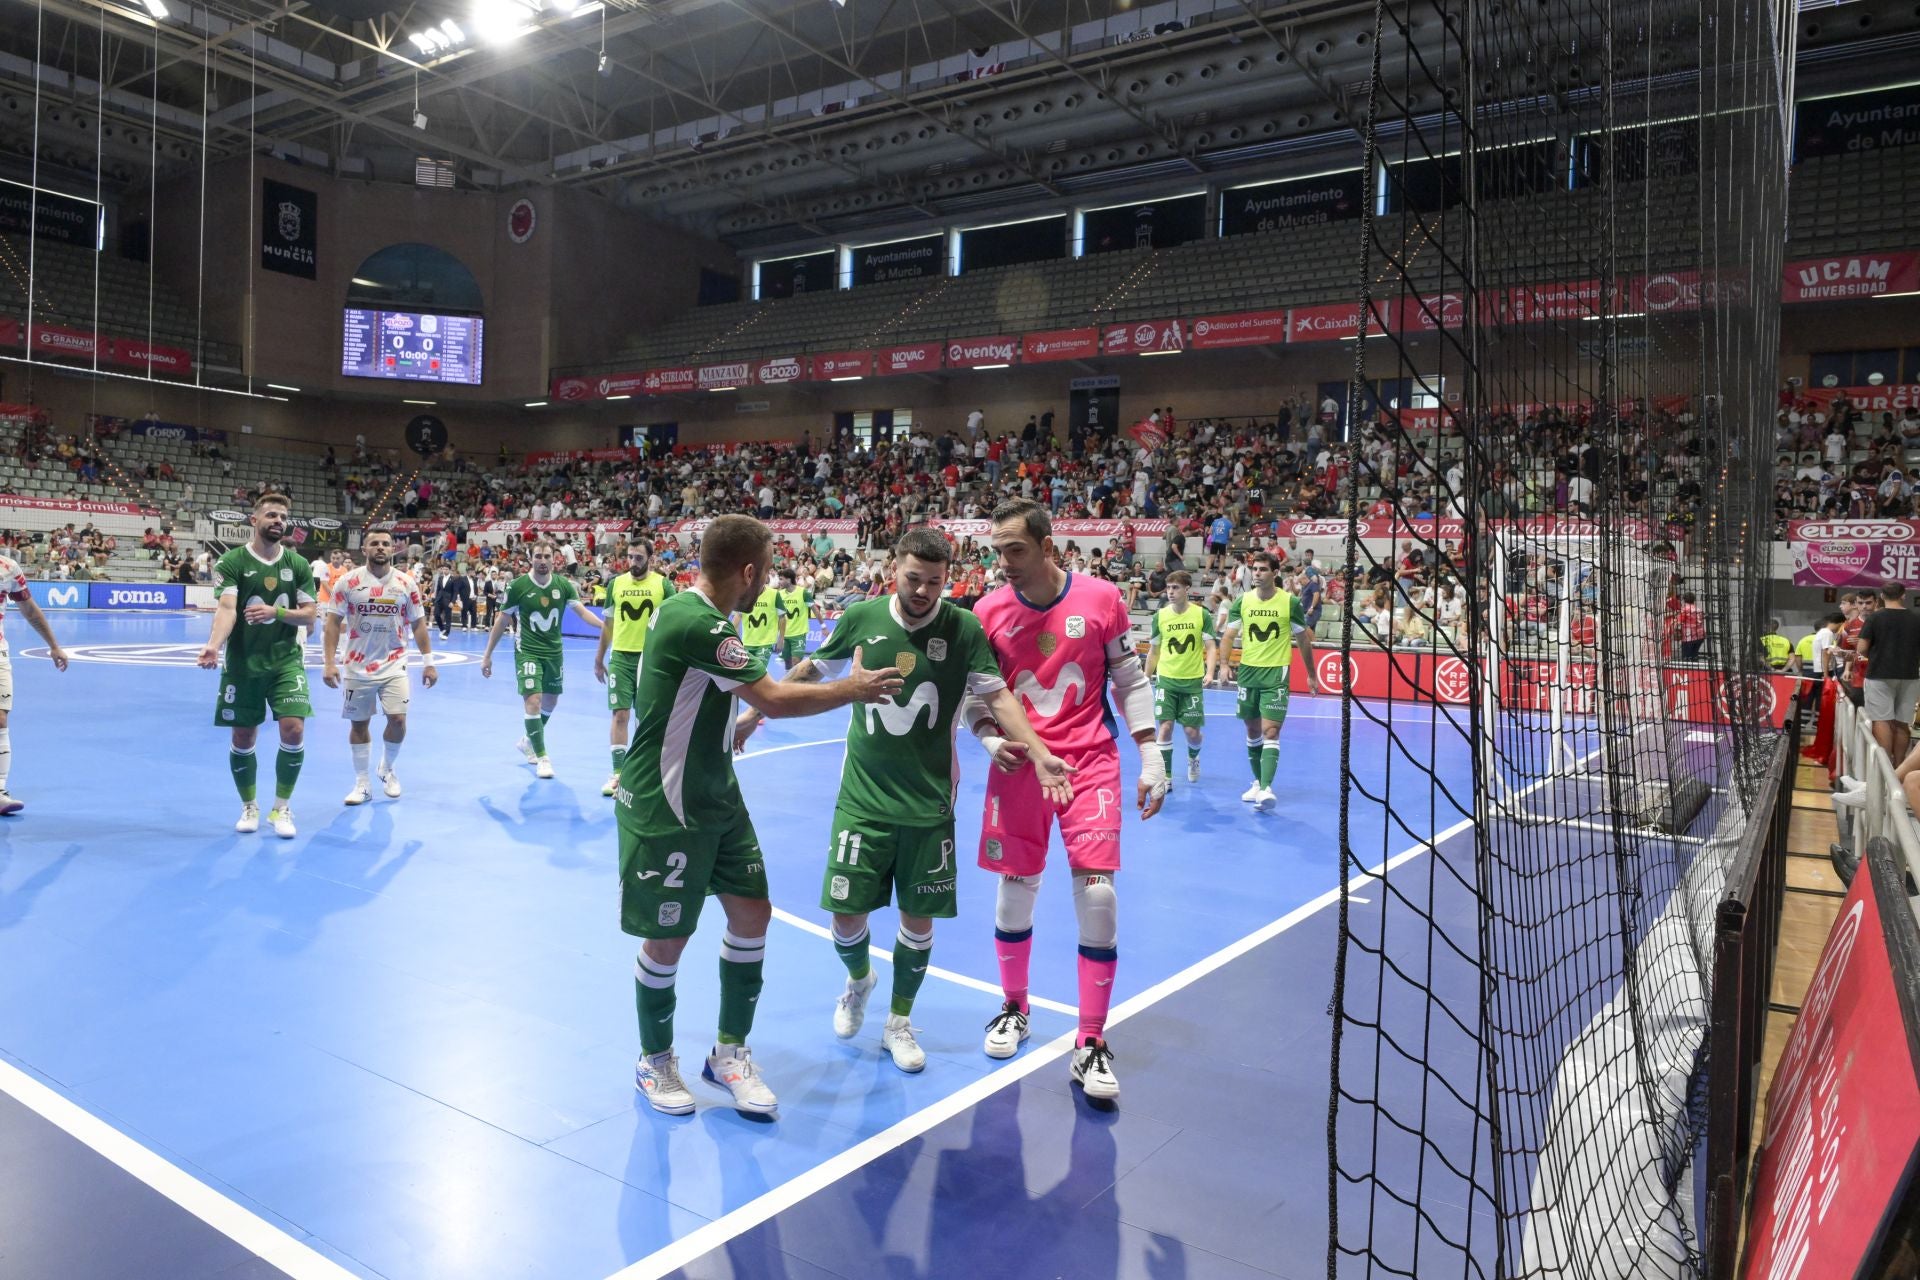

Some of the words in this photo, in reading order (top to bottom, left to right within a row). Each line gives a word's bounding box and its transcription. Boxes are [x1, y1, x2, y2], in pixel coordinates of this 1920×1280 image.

[1244, 187, 1344, 214] Ayuntamiento
[1257, 218, 1275, 231] de
[1278, 210, 1328, 228] Murcia
[865, 247, 933, 266] Ayuntamiento
[874, 269, 886, 281] de
[888, 266, 922, 279] Murcia
[1799, 258, 1891, 287] UCAM
[1799, 281, 1888, 298] UNIVERSIDAD
[1210, 321, 1238, 330] Aditivos
[1239, 320, 1251, 328] del
[1253, 318, 1282, 327] Sureste
[393, 335, 404, 349] 0
[422, 338, 434, 352] 0
[129, 350, 142, 358] LA
[142, 352, 177, 364] VERDAD
[399, 351, 428, 360] 10:00
[892, 350, 925, 363] NOVAC
[702, 364, 744, 380] MANZANO
[1853, 396, 1919, 409] URCI
[36, 499, 54, 507] de
[59, 500, 72, 509] la
[76, 500, 129, 513] familia
[783, 521, 798, 530] de
[808, 519, 856, 532] familia
[1073, 520, 1090, 531] de
[1095, 520, 1109, 531] la
[1882, 544, 1916, 556] PARA
[1810, 554, 1866, 566] bienstar
[1119, 635, 1131, 652] C
[522, 661, 537, 676] 10
[609, 673, 617, 689] 6
[224, 684, 237, 704] 8
[991, 795, 1000, 828] 1
[836, 829, 863, 866] 11
[663, 851, 688, 888] 2
